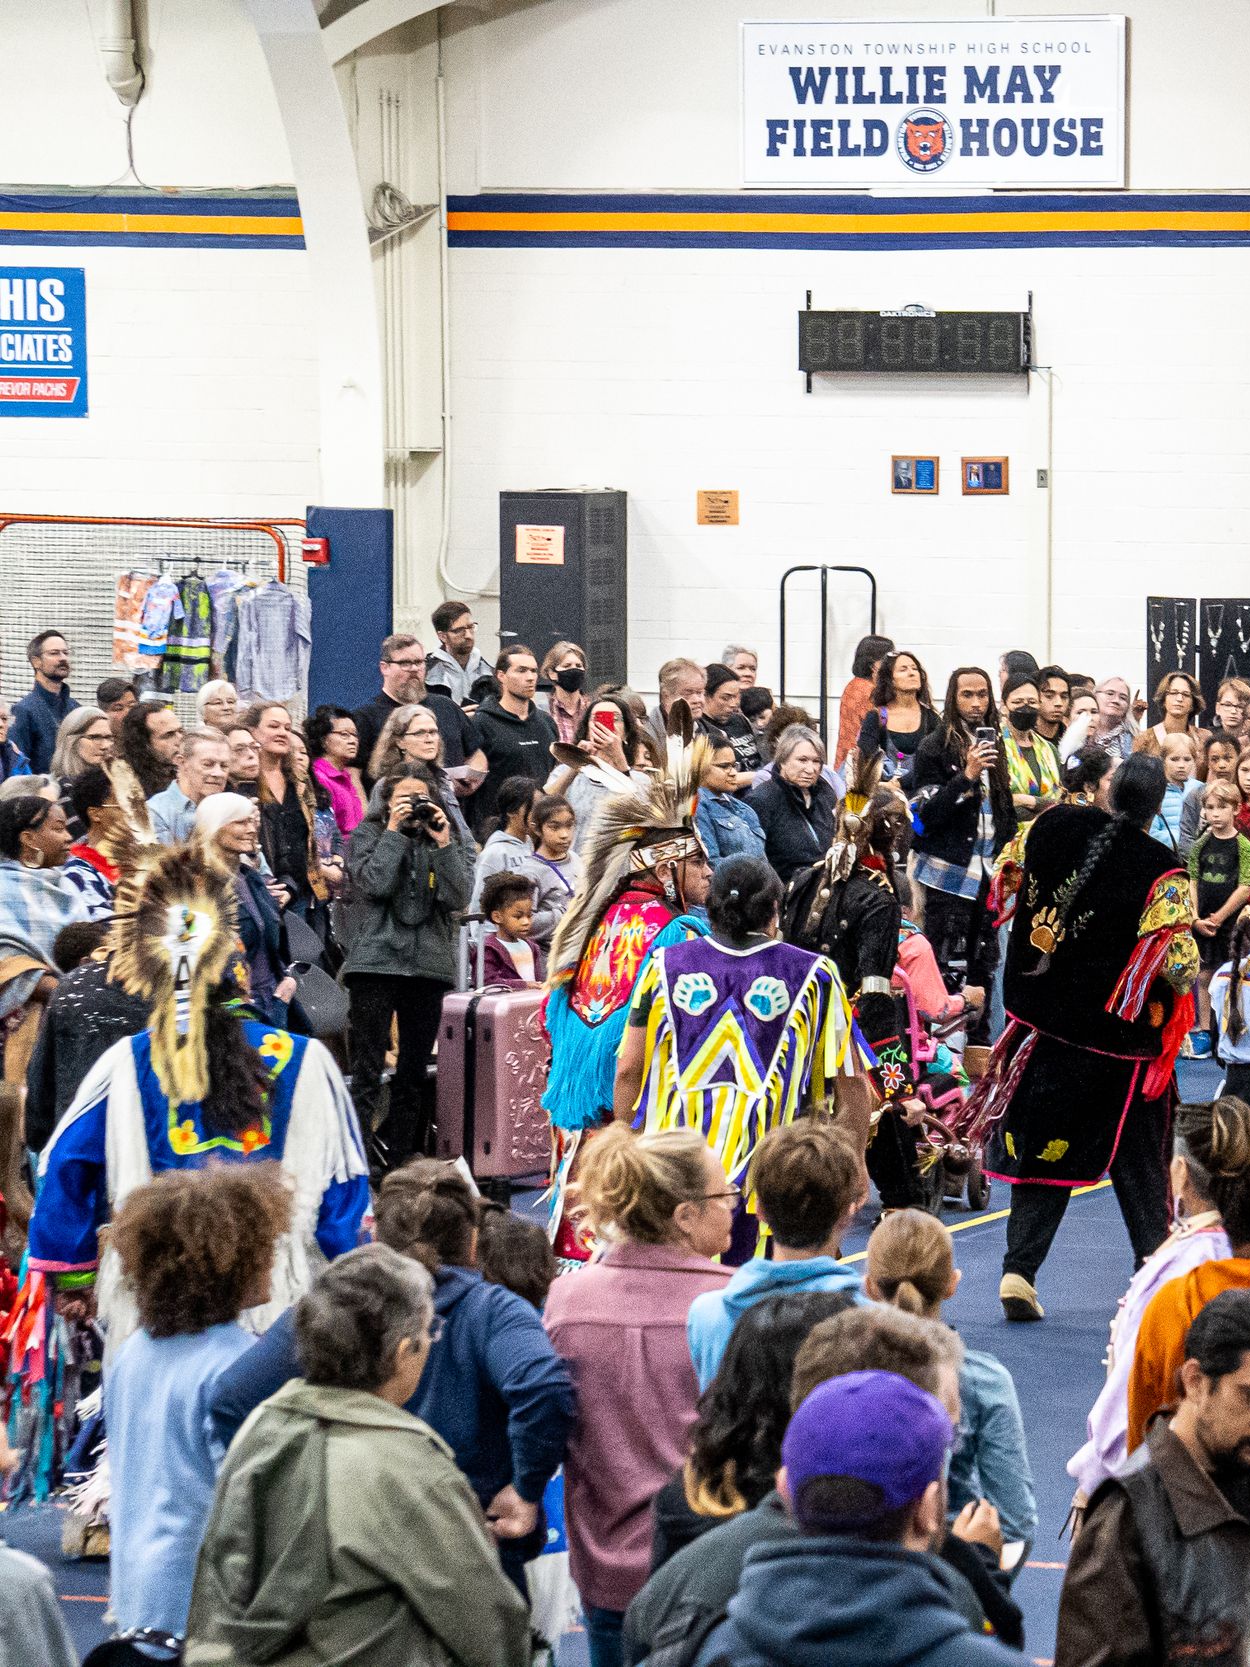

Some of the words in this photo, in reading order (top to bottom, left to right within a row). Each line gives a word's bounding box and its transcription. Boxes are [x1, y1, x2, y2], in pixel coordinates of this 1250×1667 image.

[757, 42, 853, 56] EVANSTON
[863, 42, 957, 56] TOWNSHIP
[966, 41, 1010, 55] HIGH
[1020, 41, 1092, 55] SCHOOL
[788, 65, 947, 105] WILLIE
[963, 64, 1062, 104] MAY
[766, 118, 890, 158] FIELD
[959, 117, 1104, 157] HOUSE
[0, 278, 65, 323] HIS
[0, 333, 73, 363] CIATES
[32, 382, 68, 397] PACHIS
